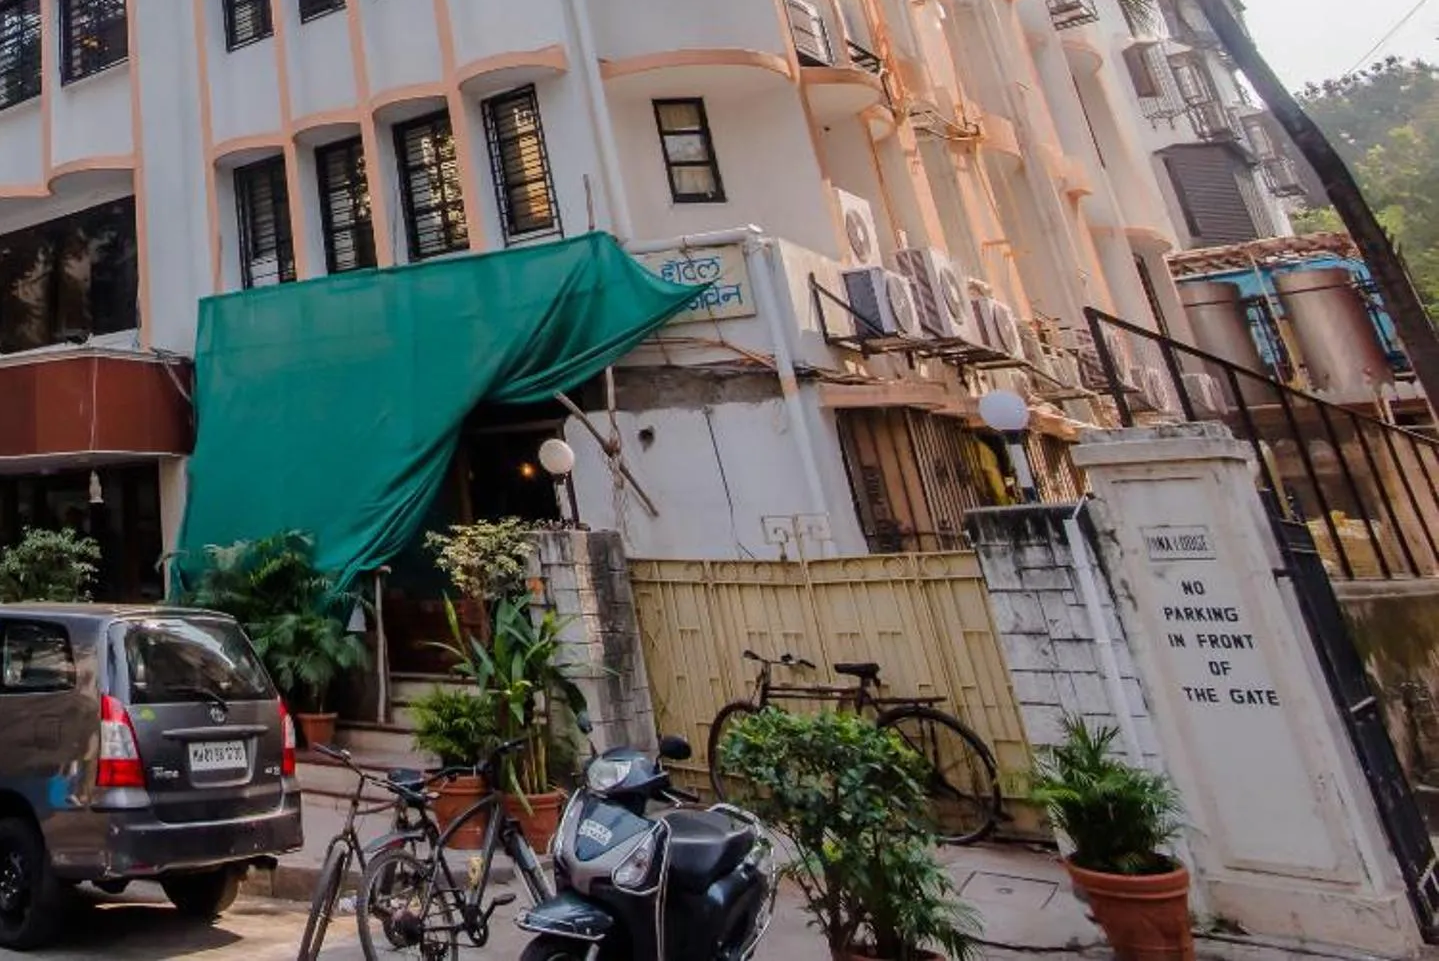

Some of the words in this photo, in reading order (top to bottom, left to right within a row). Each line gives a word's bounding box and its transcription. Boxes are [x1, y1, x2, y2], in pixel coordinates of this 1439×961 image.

[1181, 580, 1206, 595] NO
[1163, 607, 1239, 623] PARKING
[1168, 633, 1186, 648] IN
[1197, 633, 1254, 650] FRONT
[1208, 661, 1232, 676] OF
[1182, 686, 1220, 704] THE
[1229, 688, 1281, 707] GATE
